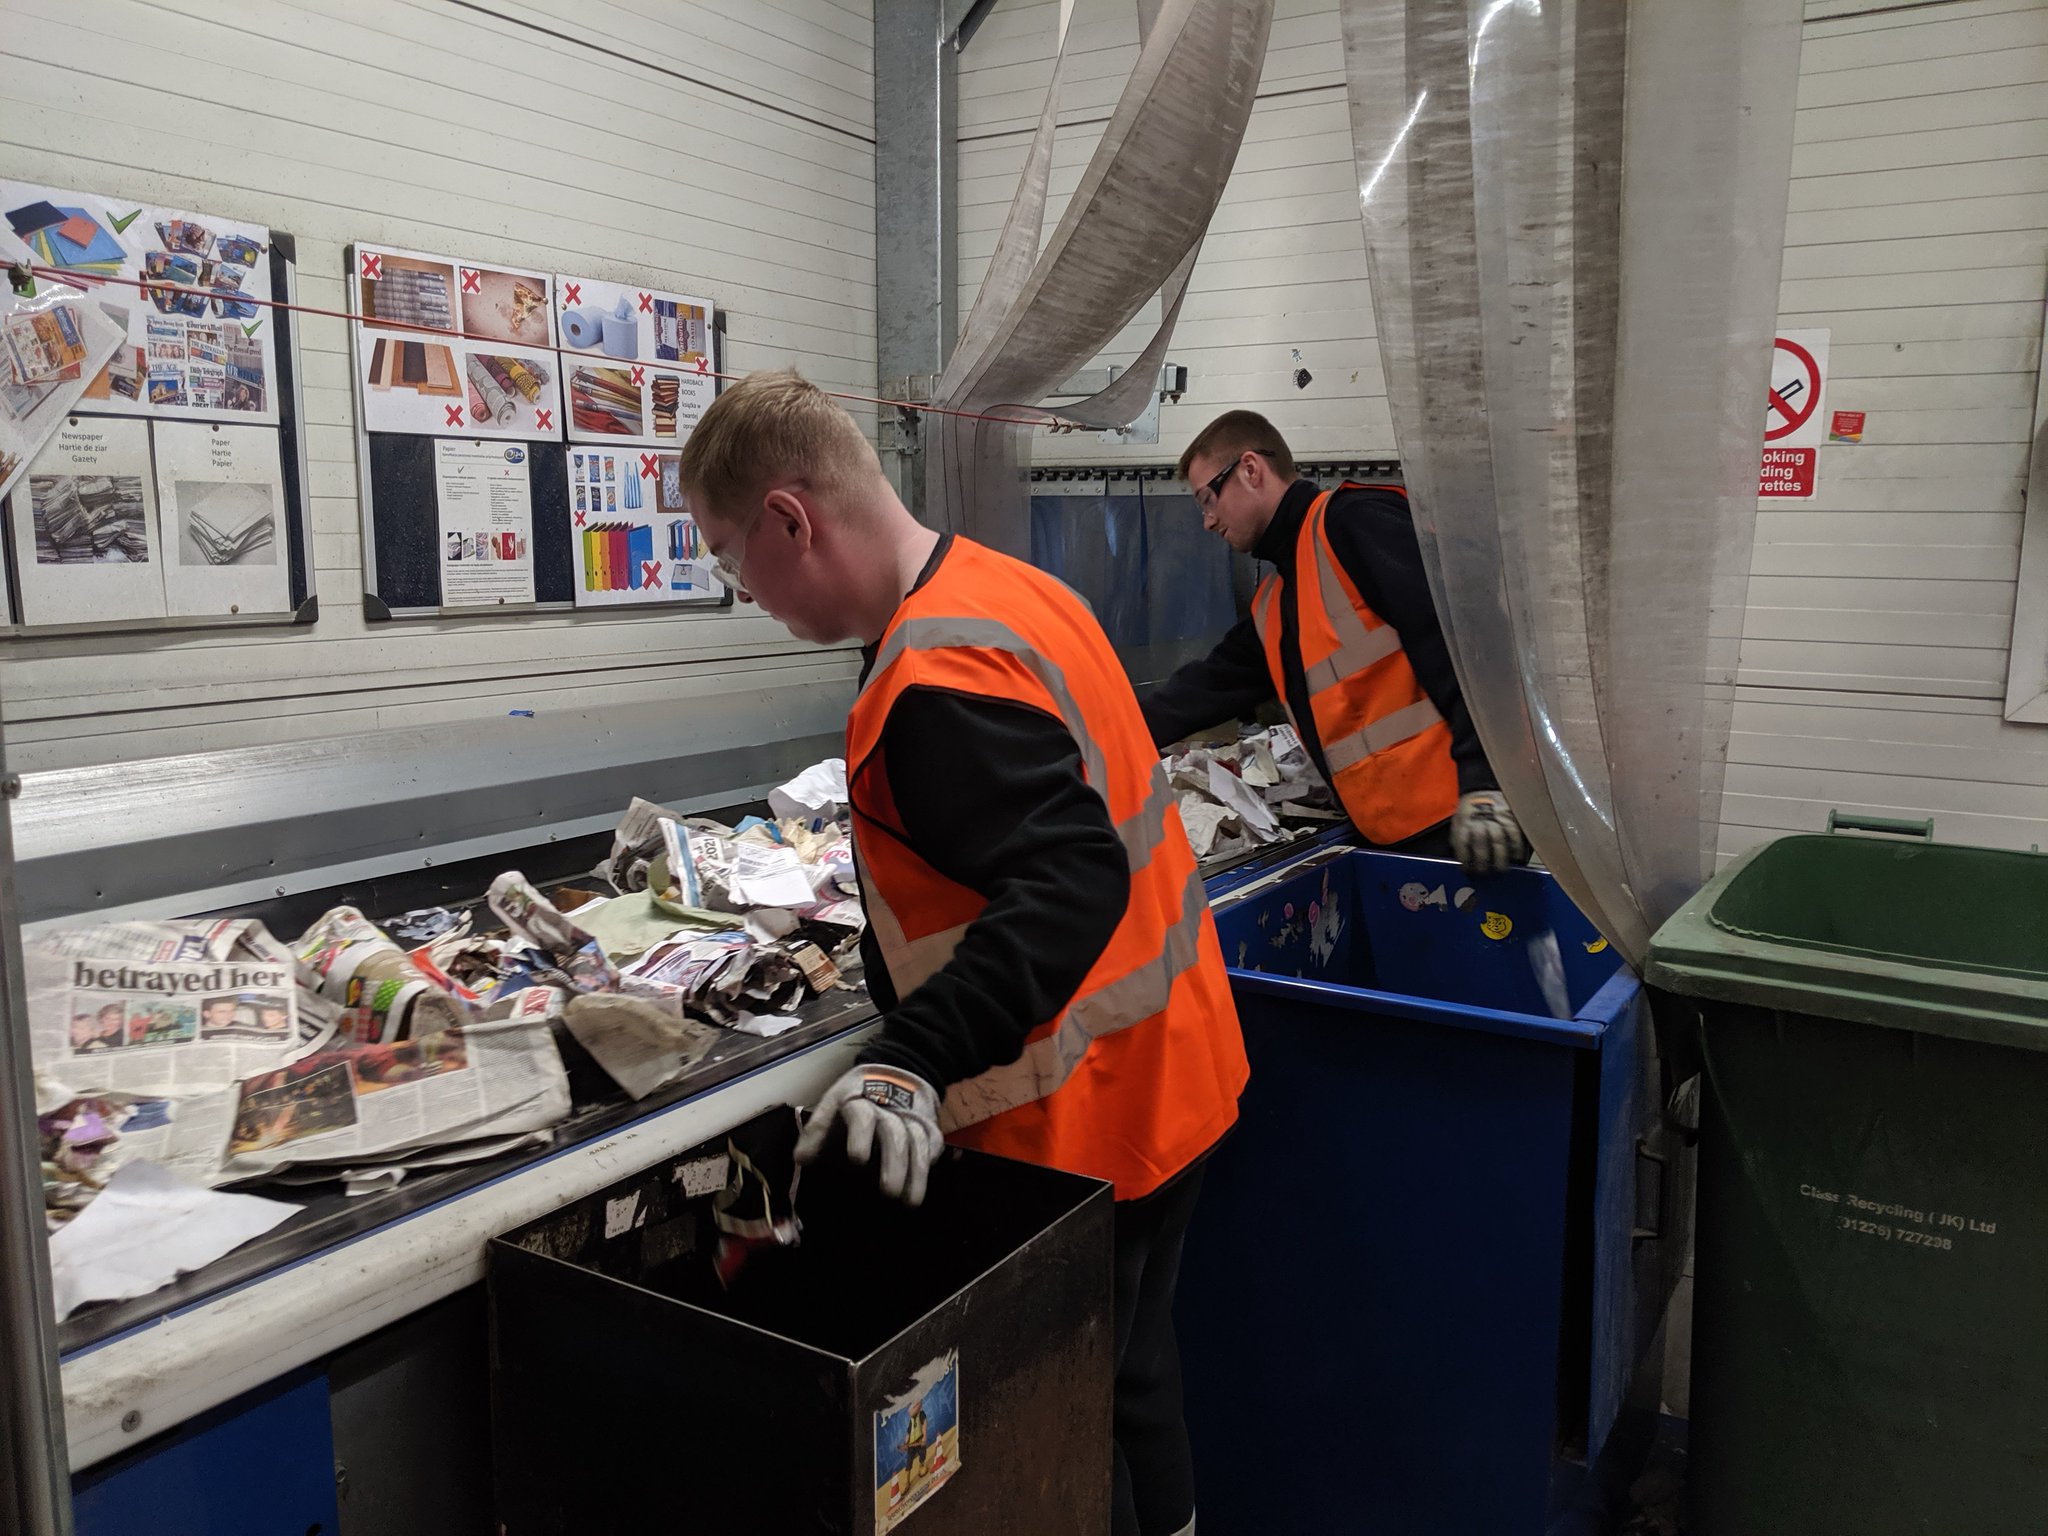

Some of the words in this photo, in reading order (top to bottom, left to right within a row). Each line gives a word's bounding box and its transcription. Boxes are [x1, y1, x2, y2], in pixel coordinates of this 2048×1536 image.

[677, 311, 685, 357] Warburtons
[681, 378, 704, 386] HARDBACK
[681, 388, 696, 397] BOOKS
[61, 432, 103, 441] Newspaper
[211, 438, 230, 447] Paper
[58, 443, 82, 451] Hartie
[83, 444, 93, 452] de
[211, 449, 232, 457] Hartie
[71, 454, 98, 464] Gazety
[212, 459, 233, 468] Papier
[74, 961, 223, 997] betrayed
[229, 967, 287, 988] her
[1799, 1183, 1841, 1203] Class
[1845, 1194, 1924, 1223] Recycling
[1969, 1218, 1997, 1234] Ltd
